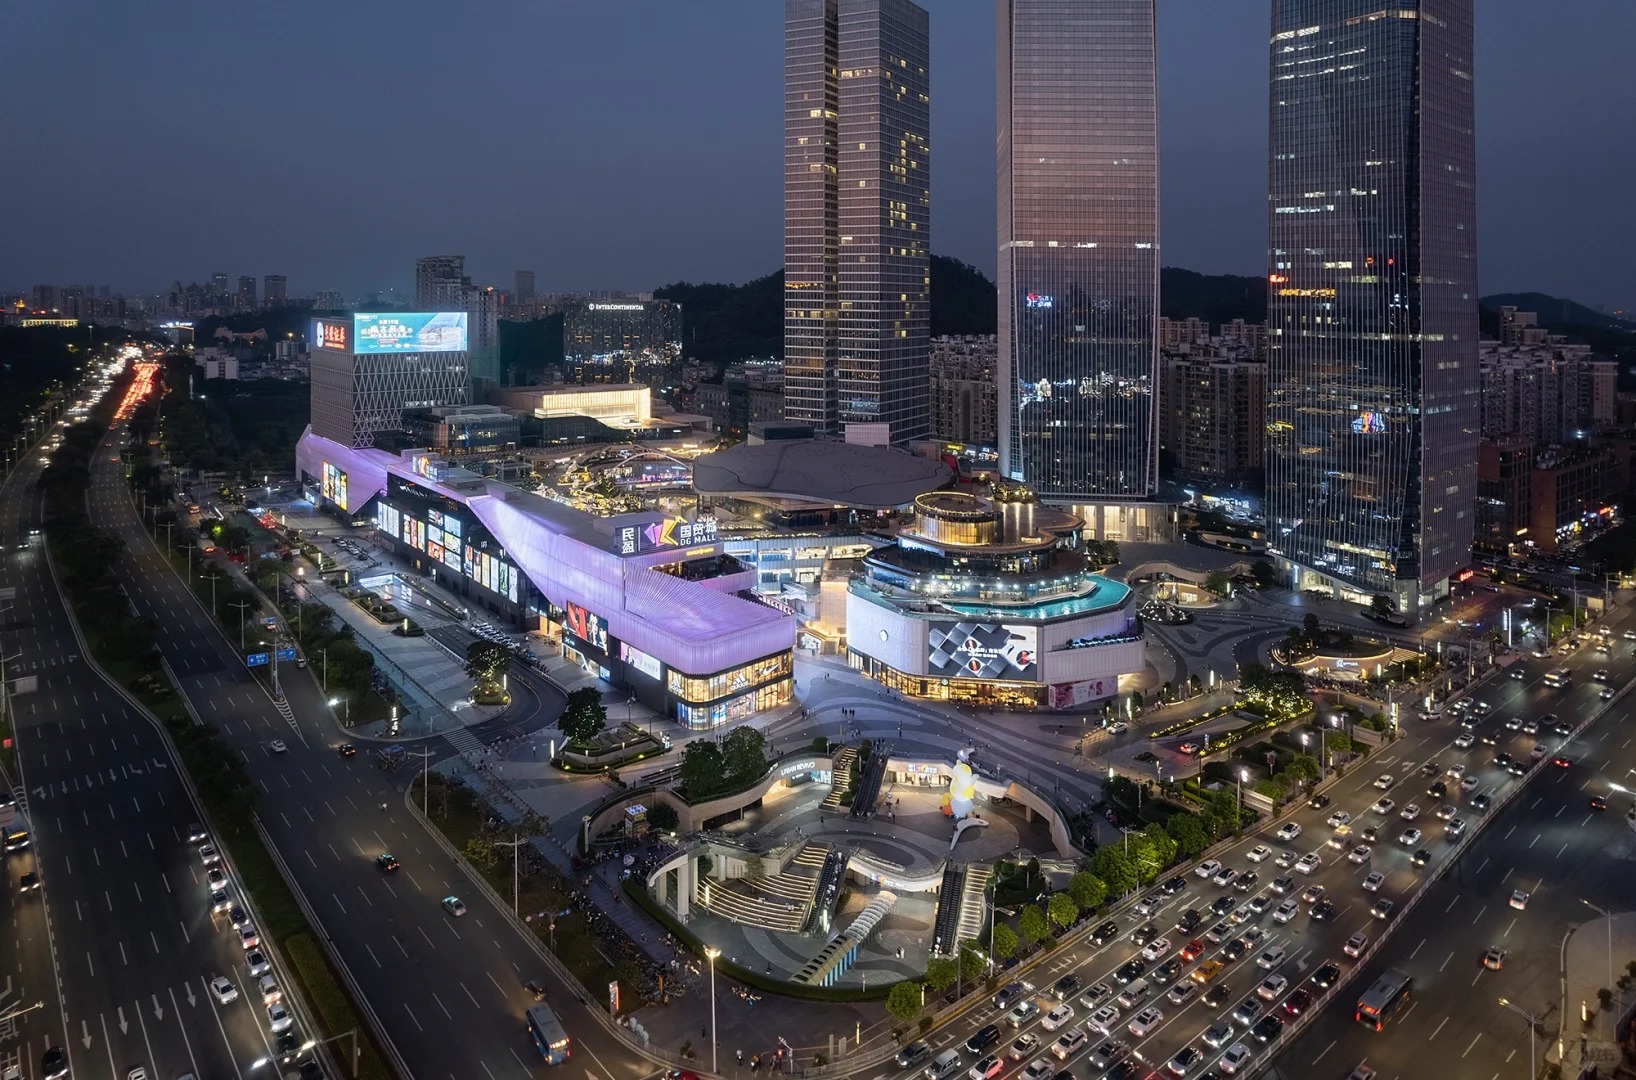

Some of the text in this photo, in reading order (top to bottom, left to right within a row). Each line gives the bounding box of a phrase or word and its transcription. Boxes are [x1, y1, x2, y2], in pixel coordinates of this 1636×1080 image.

[680, 521, 717, 539] 国贸城
[621, 527, 635, 555] 民盈
[680, 534, 716, 546] DG MALL
[780, 765, 797, 776] URBAN
[796, 761, 816, 771] REVIVO
